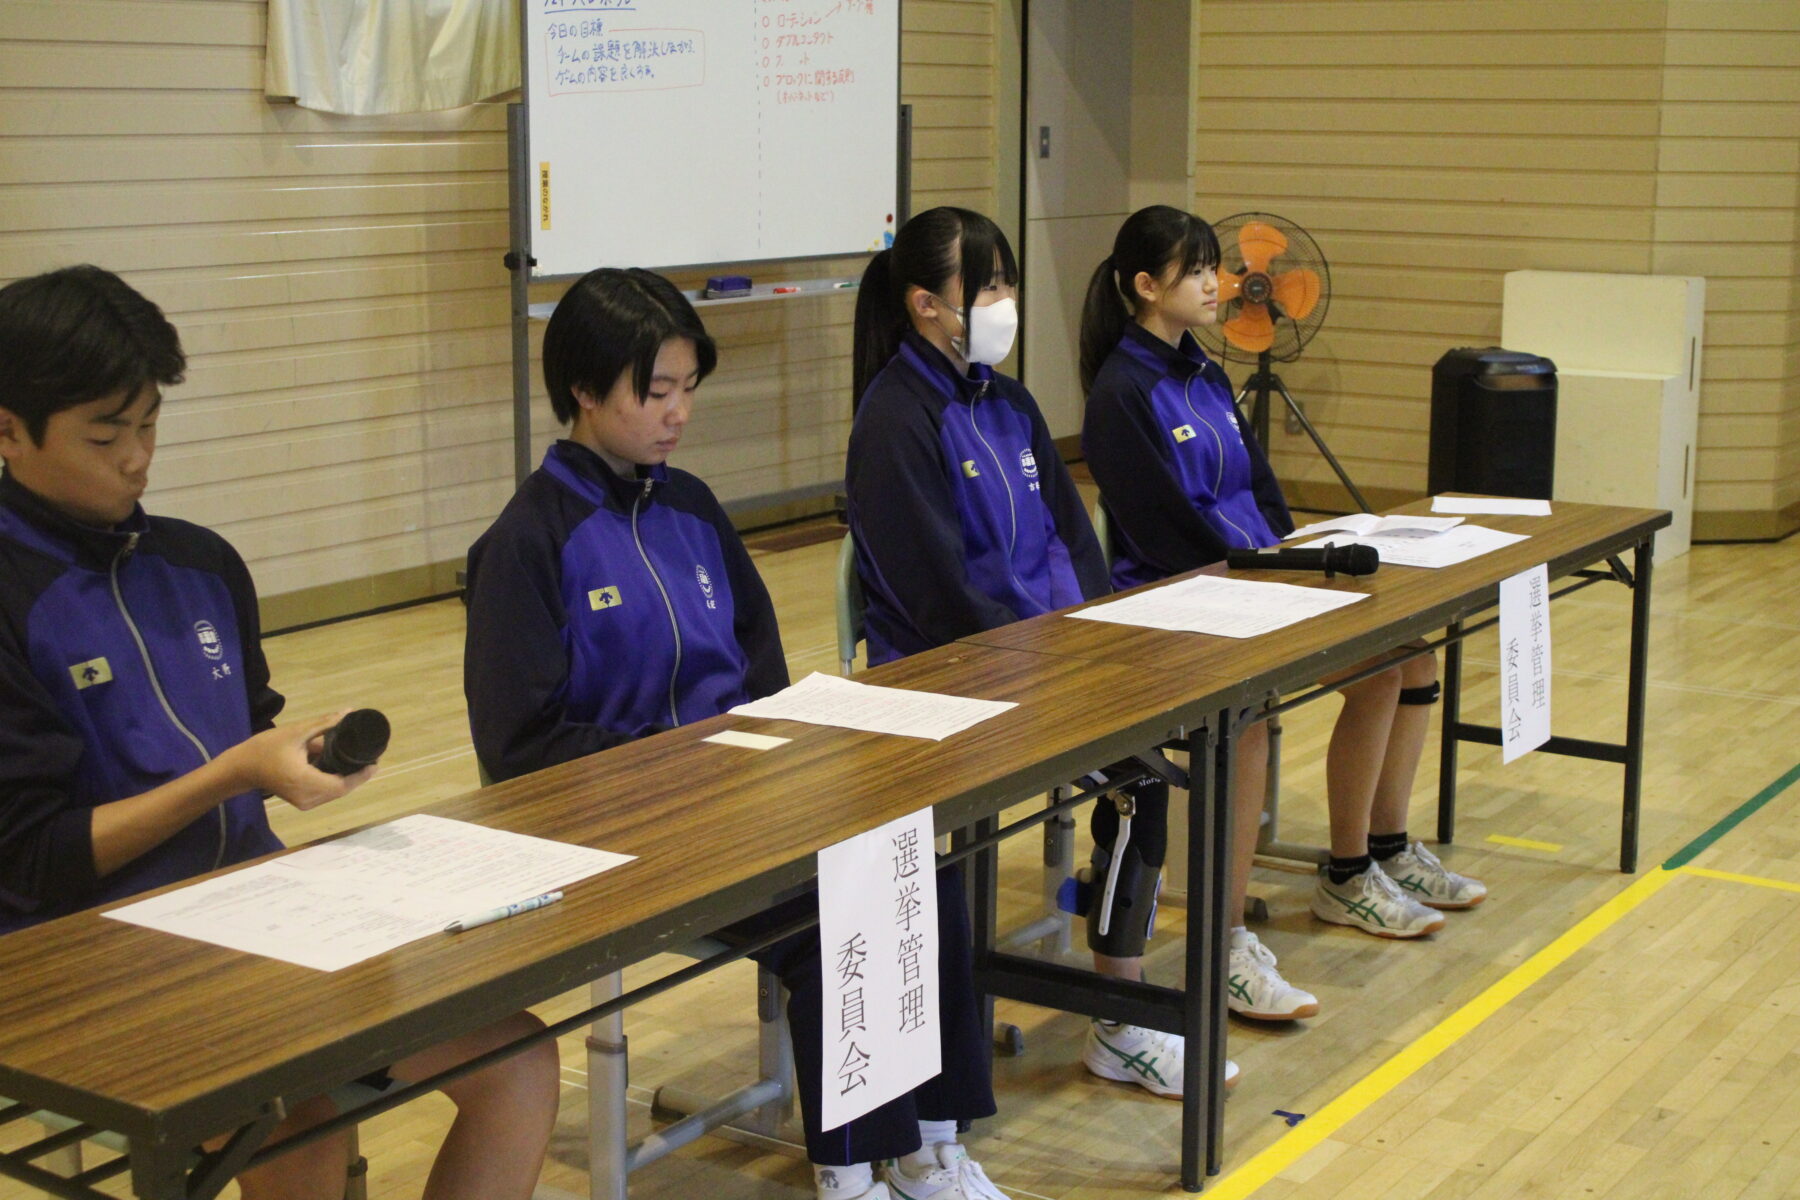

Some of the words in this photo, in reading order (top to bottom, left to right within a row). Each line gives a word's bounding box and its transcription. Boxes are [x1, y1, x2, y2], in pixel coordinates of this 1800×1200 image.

[548, 18, 604, 39] 今日の目標
[1506, 637, 1523, 743] 委員会
[1529, 575, 1546, 709] 選挙管理
[891, 827, 926, 1035] 選挙管理
[835, 931, 871, 1097] 委員会
